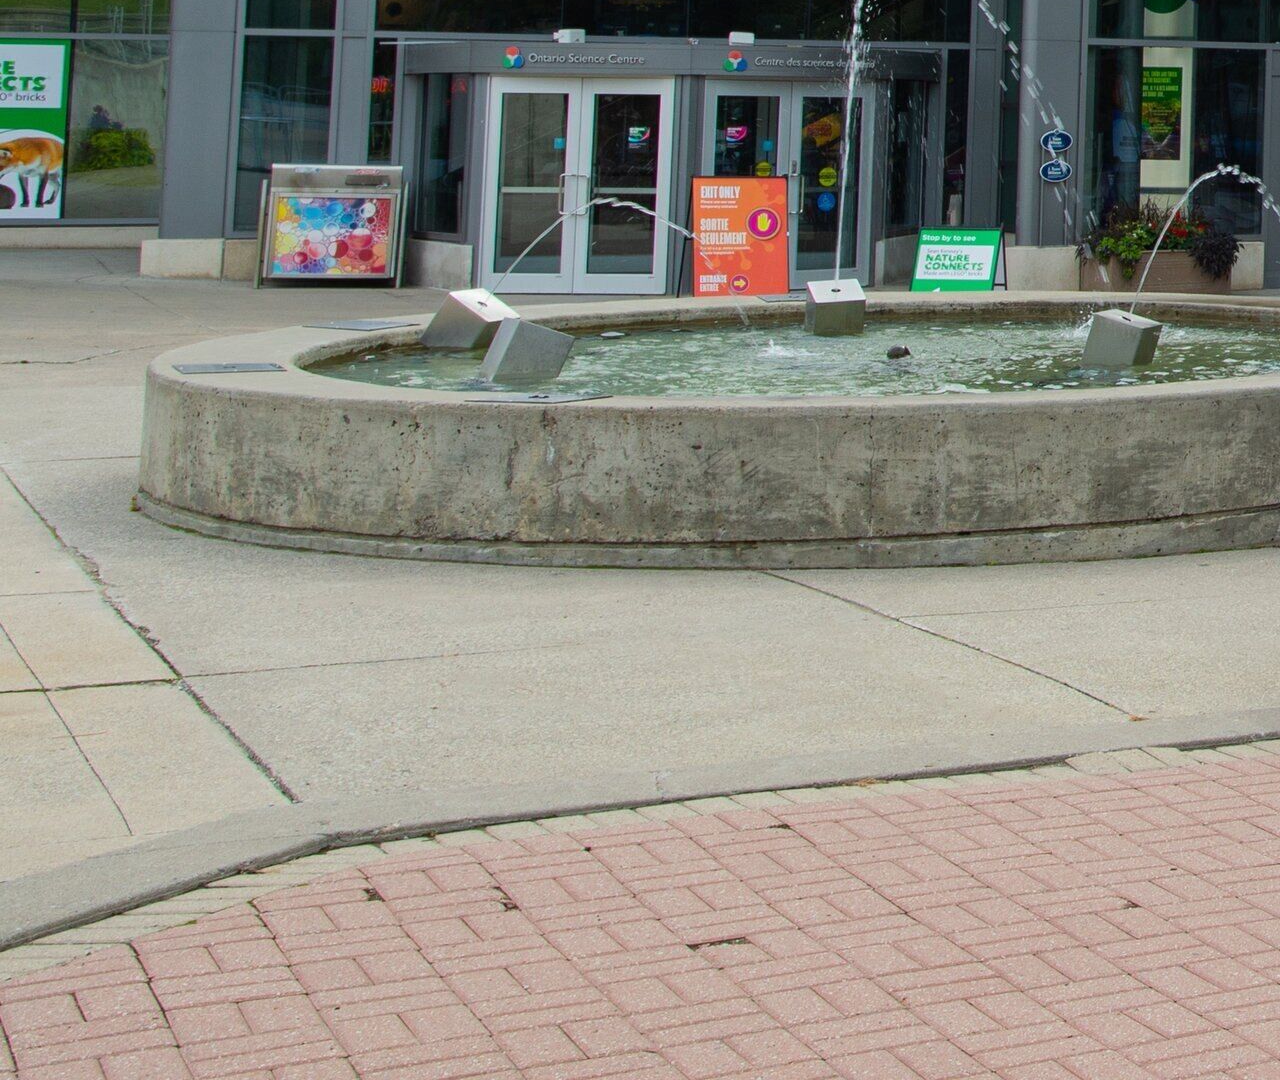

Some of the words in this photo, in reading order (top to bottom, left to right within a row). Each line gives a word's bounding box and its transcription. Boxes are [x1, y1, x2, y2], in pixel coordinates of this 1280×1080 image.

[528, 52, 566, 64] Ontario
[568, 53, 605, 64] Science
[608, 54, 646, 65] Centre
[754, 56, 784, 66] Centre
[786, 57, 801, 67] des
[803, 58, 835, 68] sciences
[15, 92, 46, 101] bricks
[700, 185, 718, 199] EXIT
[719, 185, 741, 199] ONLY
[700, 218, 729, 231] SORTIE
[700, 231, 747, 245] SEULEMENT
[922, 234, 940, 242] Stop
[925, 253, 970, 262] NATURE
[924, 261, 984, 271] CONNECTS
